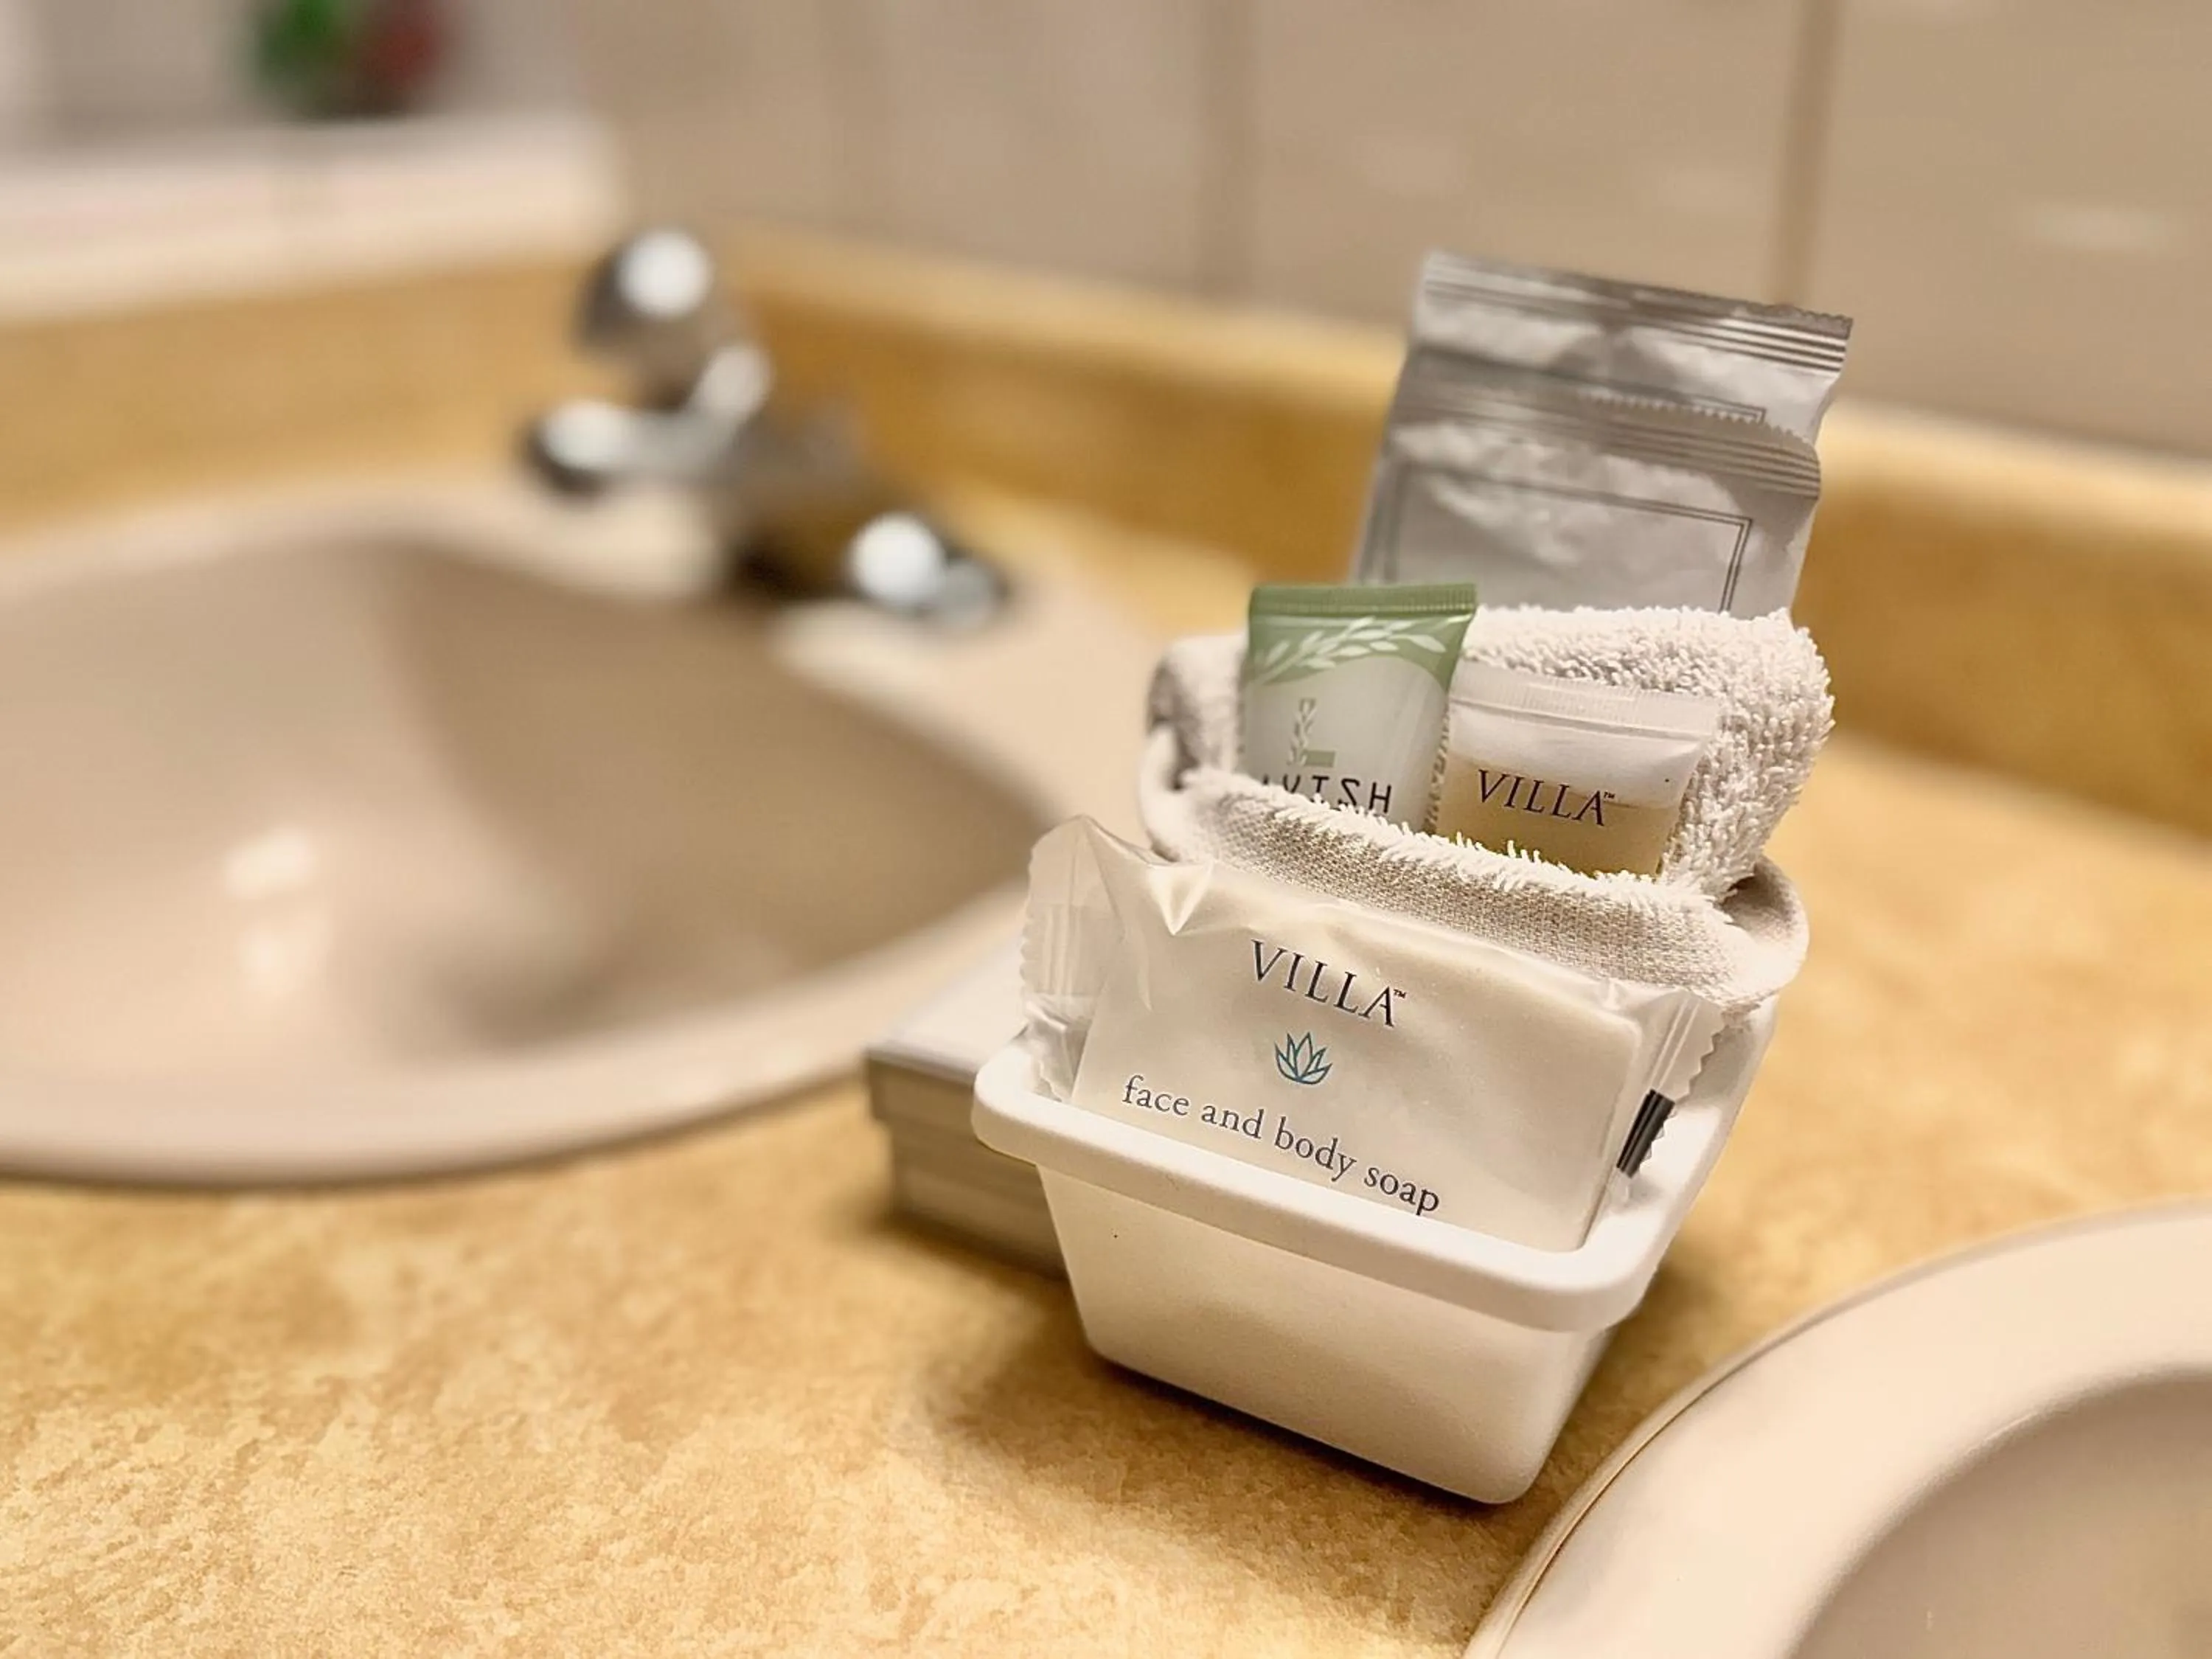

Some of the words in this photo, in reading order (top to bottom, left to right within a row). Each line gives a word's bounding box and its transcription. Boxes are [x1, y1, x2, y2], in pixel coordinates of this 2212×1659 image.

[1121, 1074, 1189, 1116] face
[1200, 1104, 1265, 1140] and
[1273, 1116, 1357, 1181] body
[1363, 1166, 1440, 1216] soap
